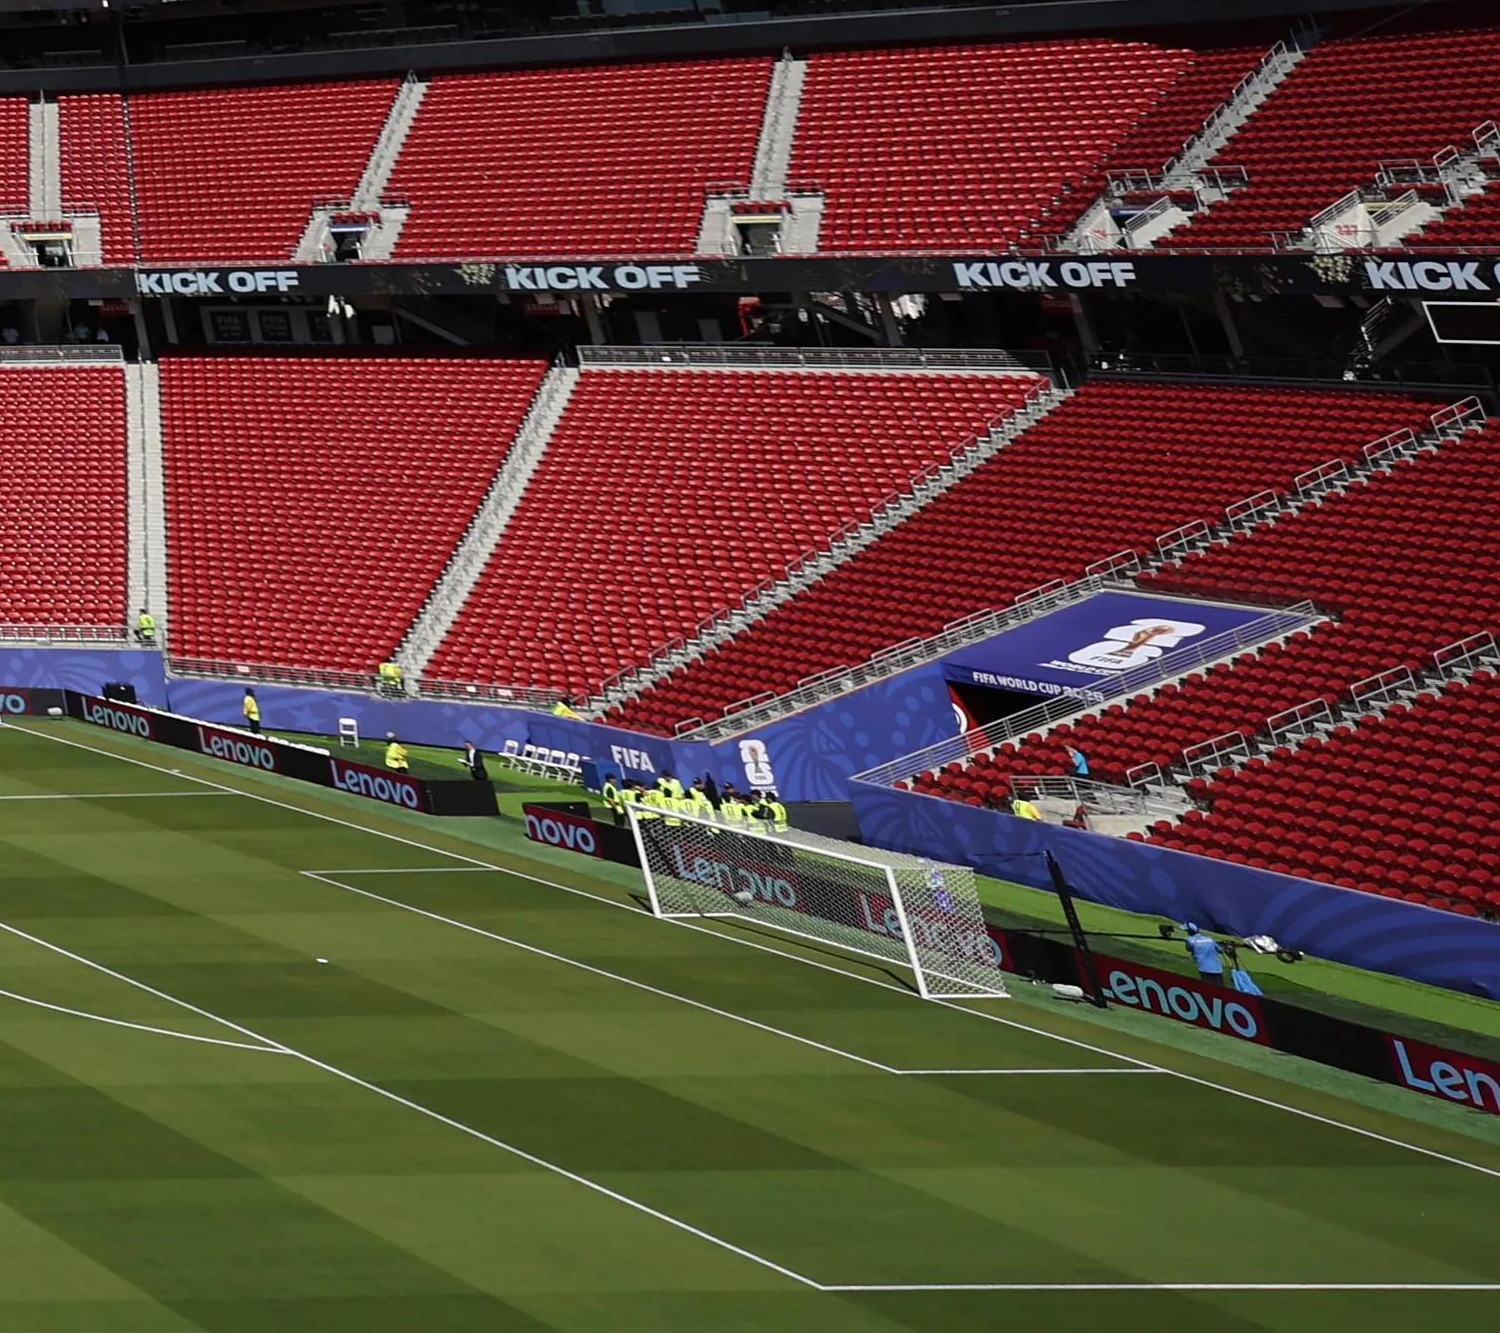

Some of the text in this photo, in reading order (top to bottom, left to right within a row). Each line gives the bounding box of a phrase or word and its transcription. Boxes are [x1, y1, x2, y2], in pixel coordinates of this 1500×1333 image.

[134, 271, 298, 294] KICK OFF
[505, 265, 700, 289] KICK OFF
[953, 262, 1136, 290] KICK OFF
[1365, 260, 1490, 290] KICK
[973, 672, 997, 686] FIFA
[998, 677, 1037, 692] WORLD
[1040, 684, 1061, 695] CUP
[81, 703, 150, 738] Lenovo
[198, 722, 276, 767] Lenovo
[610, 745, 655, 773] FIFA
[331, 758, 416, 807] Lenovo
[525, 814, 595, 851] novo
[1104, 966, 1258, 1036] enovo
